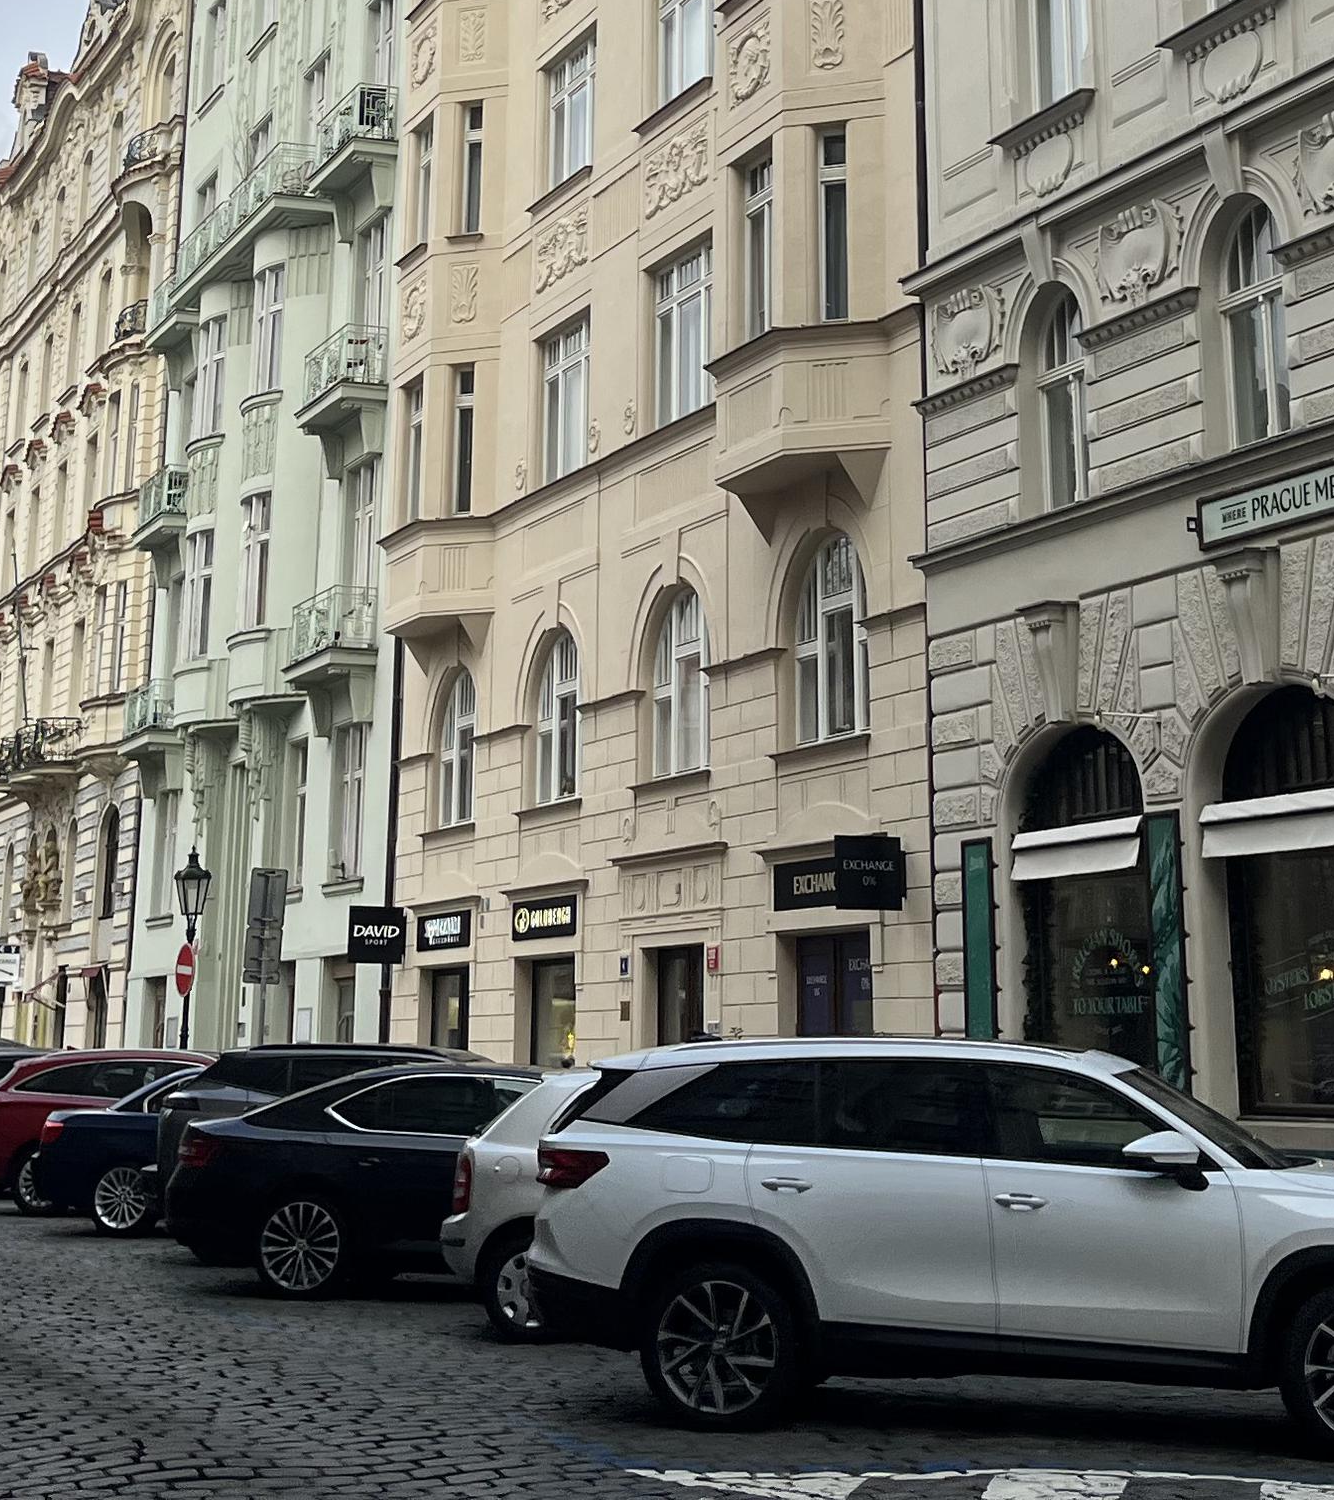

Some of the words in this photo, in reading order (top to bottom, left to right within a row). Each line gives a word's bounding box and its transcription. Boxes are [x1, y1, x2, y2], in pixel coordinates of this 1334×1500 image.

[1221, 506, 1247, 524] WHERE
[1251, 481, 1312, 521] PRAGUE
[843, 859, 895, 871] EXCHANGE
[793, 871, 836, 895] EXCHANG
[862, 875, 877, 886] 0%
[353, 924, 400, 938] DAVID
[1073, 996, 1086, 1015] TO
